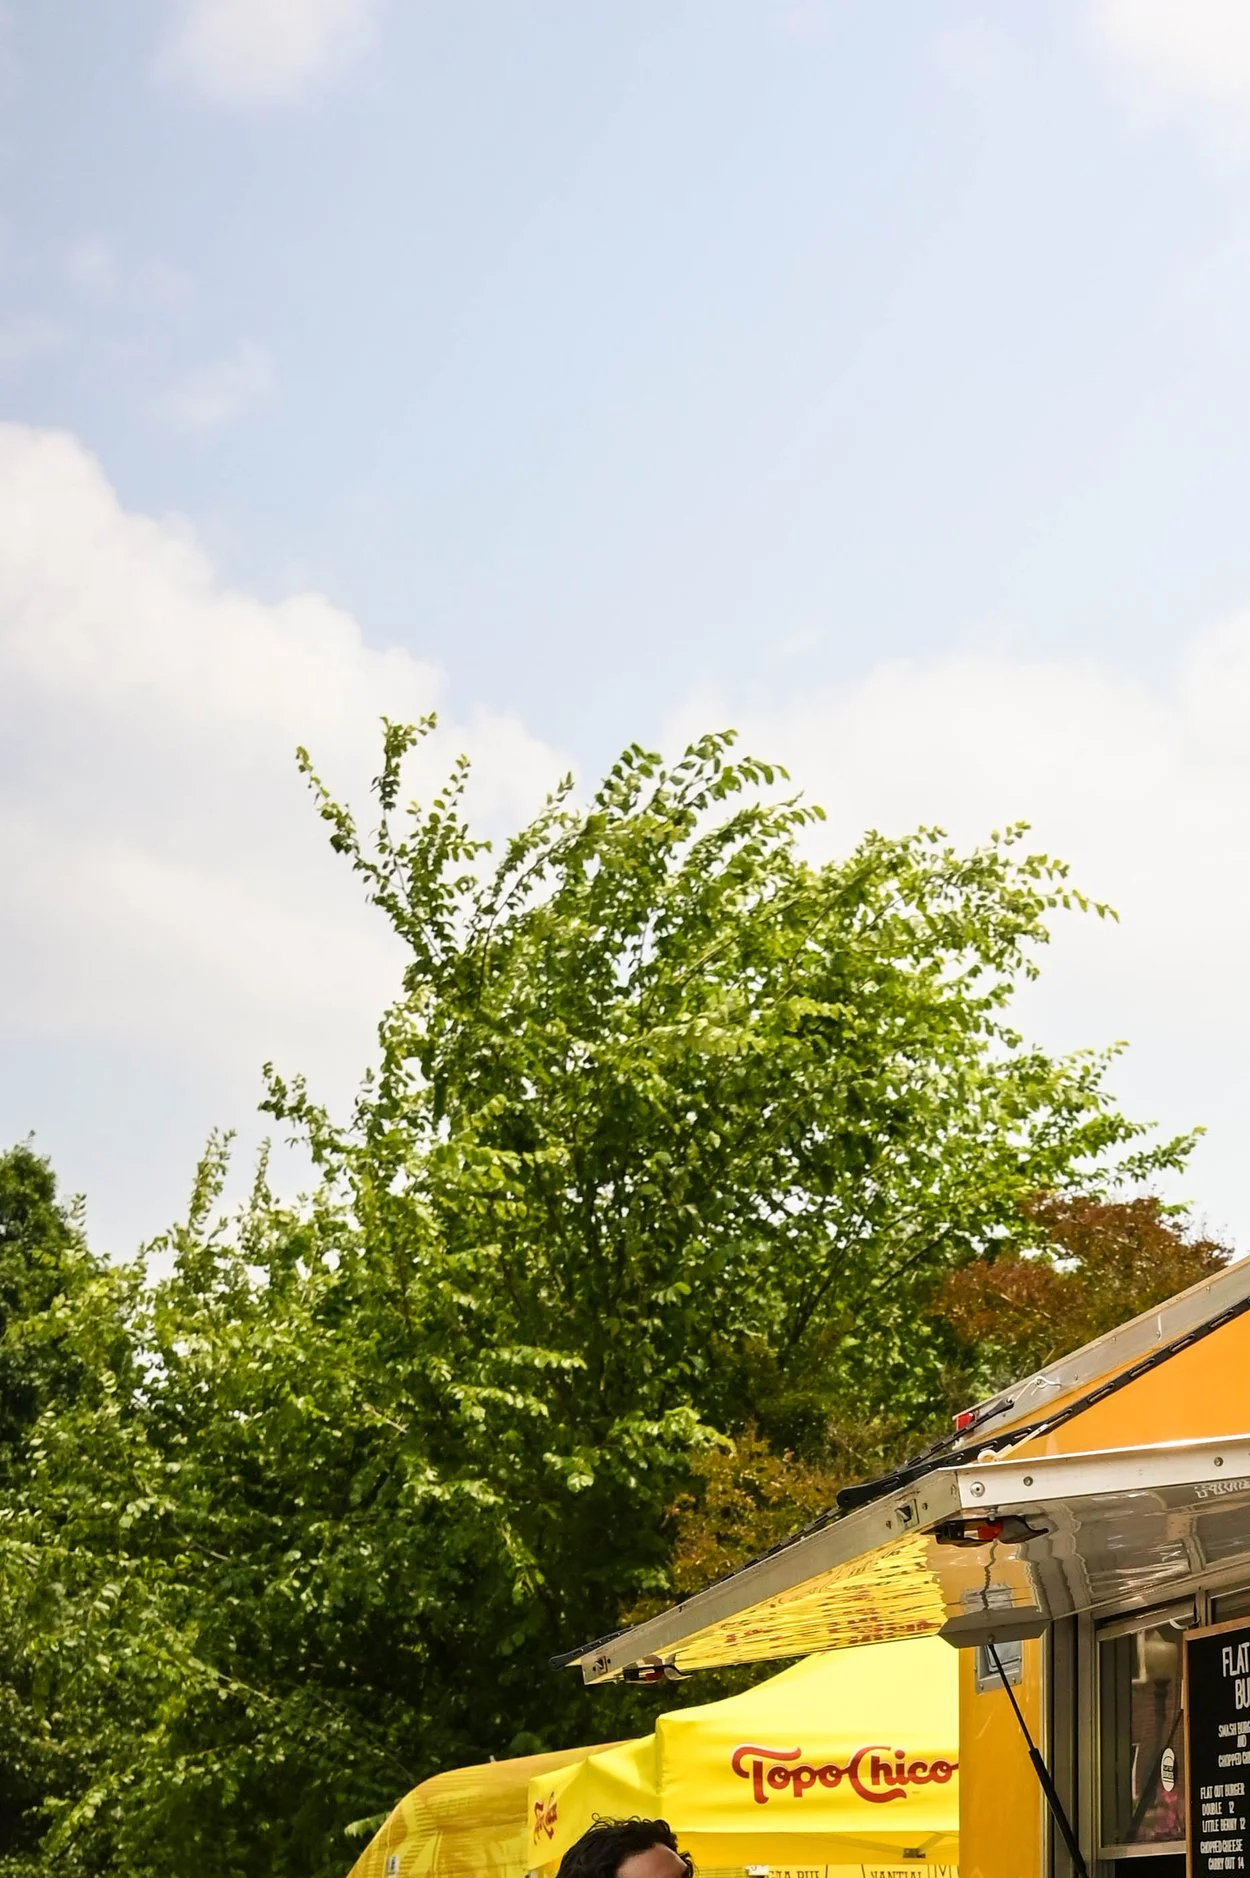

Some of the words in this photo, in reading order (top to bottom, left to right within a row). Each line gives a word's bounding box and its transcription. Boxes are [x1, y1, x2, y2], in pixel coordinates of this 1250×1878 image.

[1218, 1723, 1237, 1737] SMASH
[1218, 1752, 1241, 1767] CHOPPED
[732, 1743, 850, 1804] Topo
[849, 1745, 959, 1803] Chico
[1200, 1787, 1213, 1799] FLAT
[1214, 1785, 1224, 1798] OUT
[1224, 1783, 1245, 1797] BURGER
[1202, 1802, 1222, 1816] DOUBLE
[1202, 1819, 1219, 1833] LITTLE
[1238, 1856, 1245, 1869] 14
